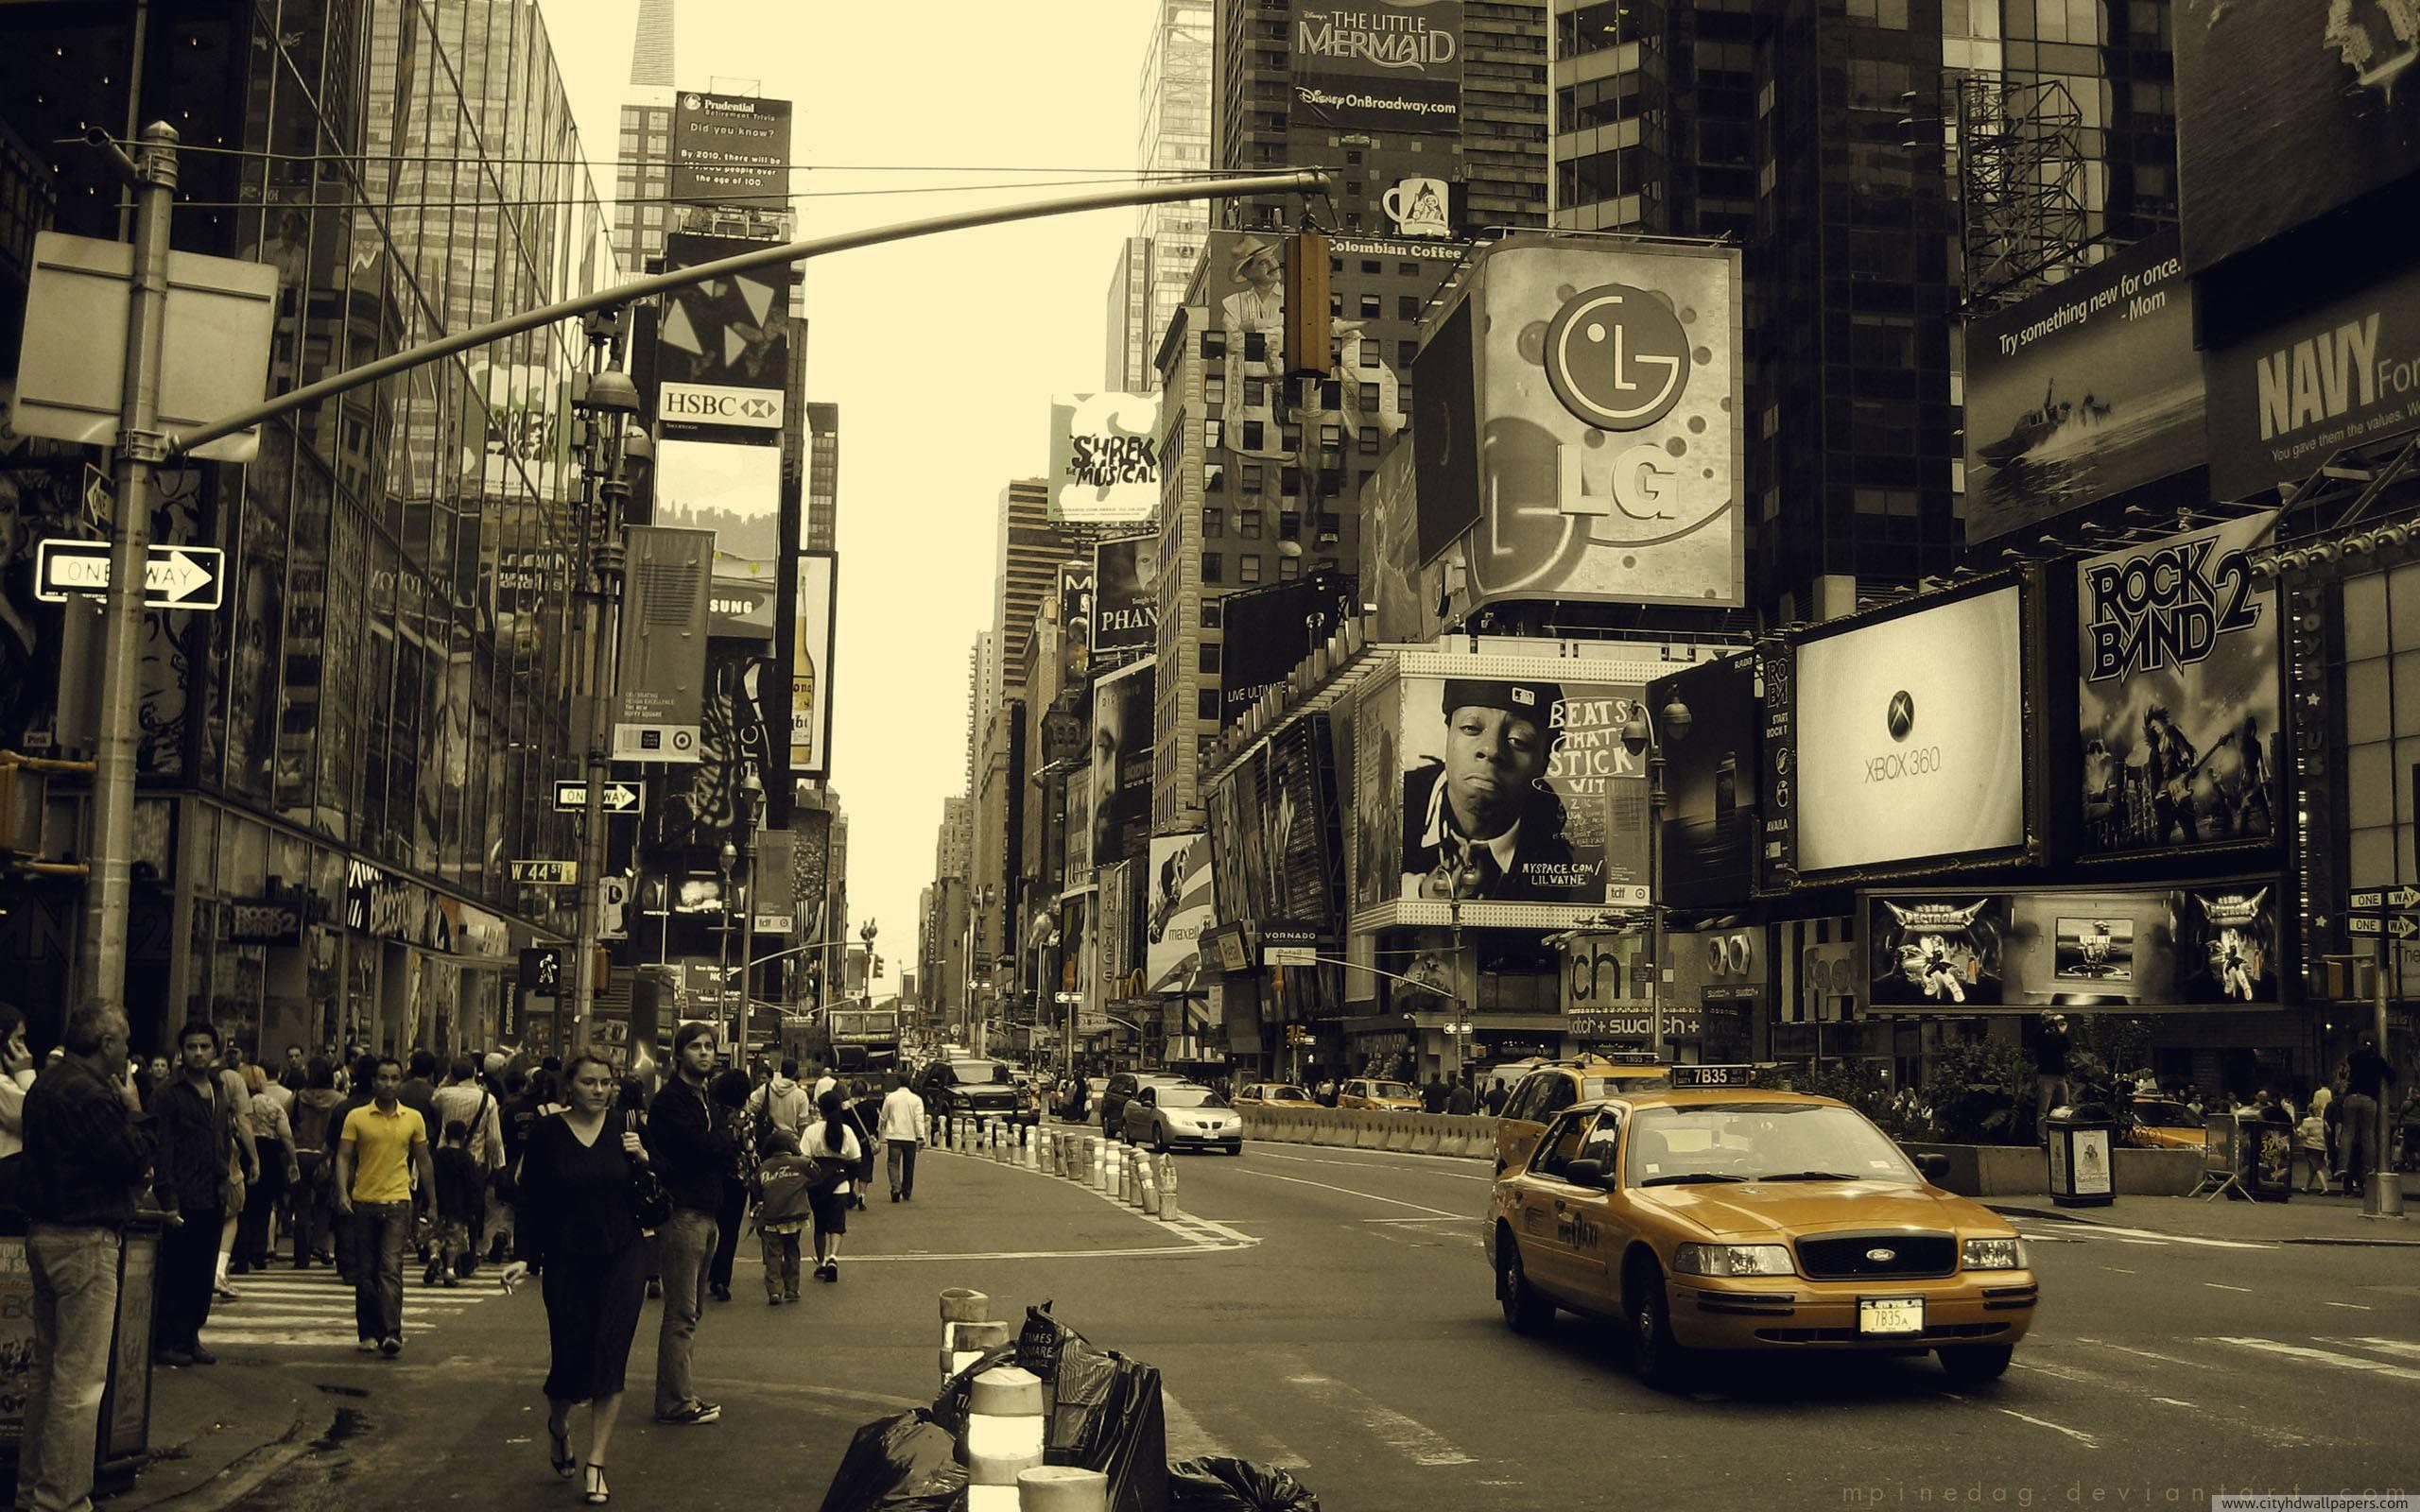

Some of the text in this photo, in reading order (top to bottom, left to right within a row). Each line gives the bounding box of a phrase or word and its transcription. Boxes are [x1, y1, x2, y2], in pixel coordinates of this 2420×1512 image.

[1331, 11, 1426, 33] THE LITTLE
[1299, 21, 1456, 71] MERMAID
[704, 99, 754, 113] Prudential
[690, 123, 774, 138] Did you know?
[681, 149, 693, 159] By
[697, 150, 721, 161] 2010,
[724, 153, 748, 163] there
[752, 155, 768, 163] will
[696, 174, 711, 182] the
[1410, 245, 1461, 259] Coffee
[1999, 257, 2182, 356] Try something new for once.
[2129, 290, 2166, 322] Mom
[2256, 312, 2380, 441] NAVY
[666, 392, 736, 417] HSBC
[1069, 434, 1157, 468] SHREK
[2272, 448, 2290, 462] You
[2292, 439, 2316, 459] gave
[2319, 429, 2344, 448] them
[2346, 421, 2364, 438] the
[1075, 465, 1157, 488] MUSICAL
[1558, 443, 1679, 520] LG
[147, 567, 193, 586] WAY
[2084, 535, 2263, 639] ROCK 2
[2086, 602, 2218, 687] BAND
[1548, 699, 1628, 730] BEATS
[1547, 747, 1634, 777] STICK
[1864, 746, 1941, 784] XBOX 360
[567, 790, 628, 803] ON WAY
[511, 863, 562, 881] W 44 ST
[1531, 873, 1586, 886] LIL WAYNE
[2358, 892, 2416, 906] ONE WAY
[1168, 925, 1200, 941] maxell
[2356, 919, 2411, 932] ONE WAY
[1264, 932, 1317, 940] VORNADO
[1694, 1069, 1728, 1084] 7B35
[1876, 1310, 1909, 1327] 7B35A
[1025, 1332, 1052, 1345] TIMES
